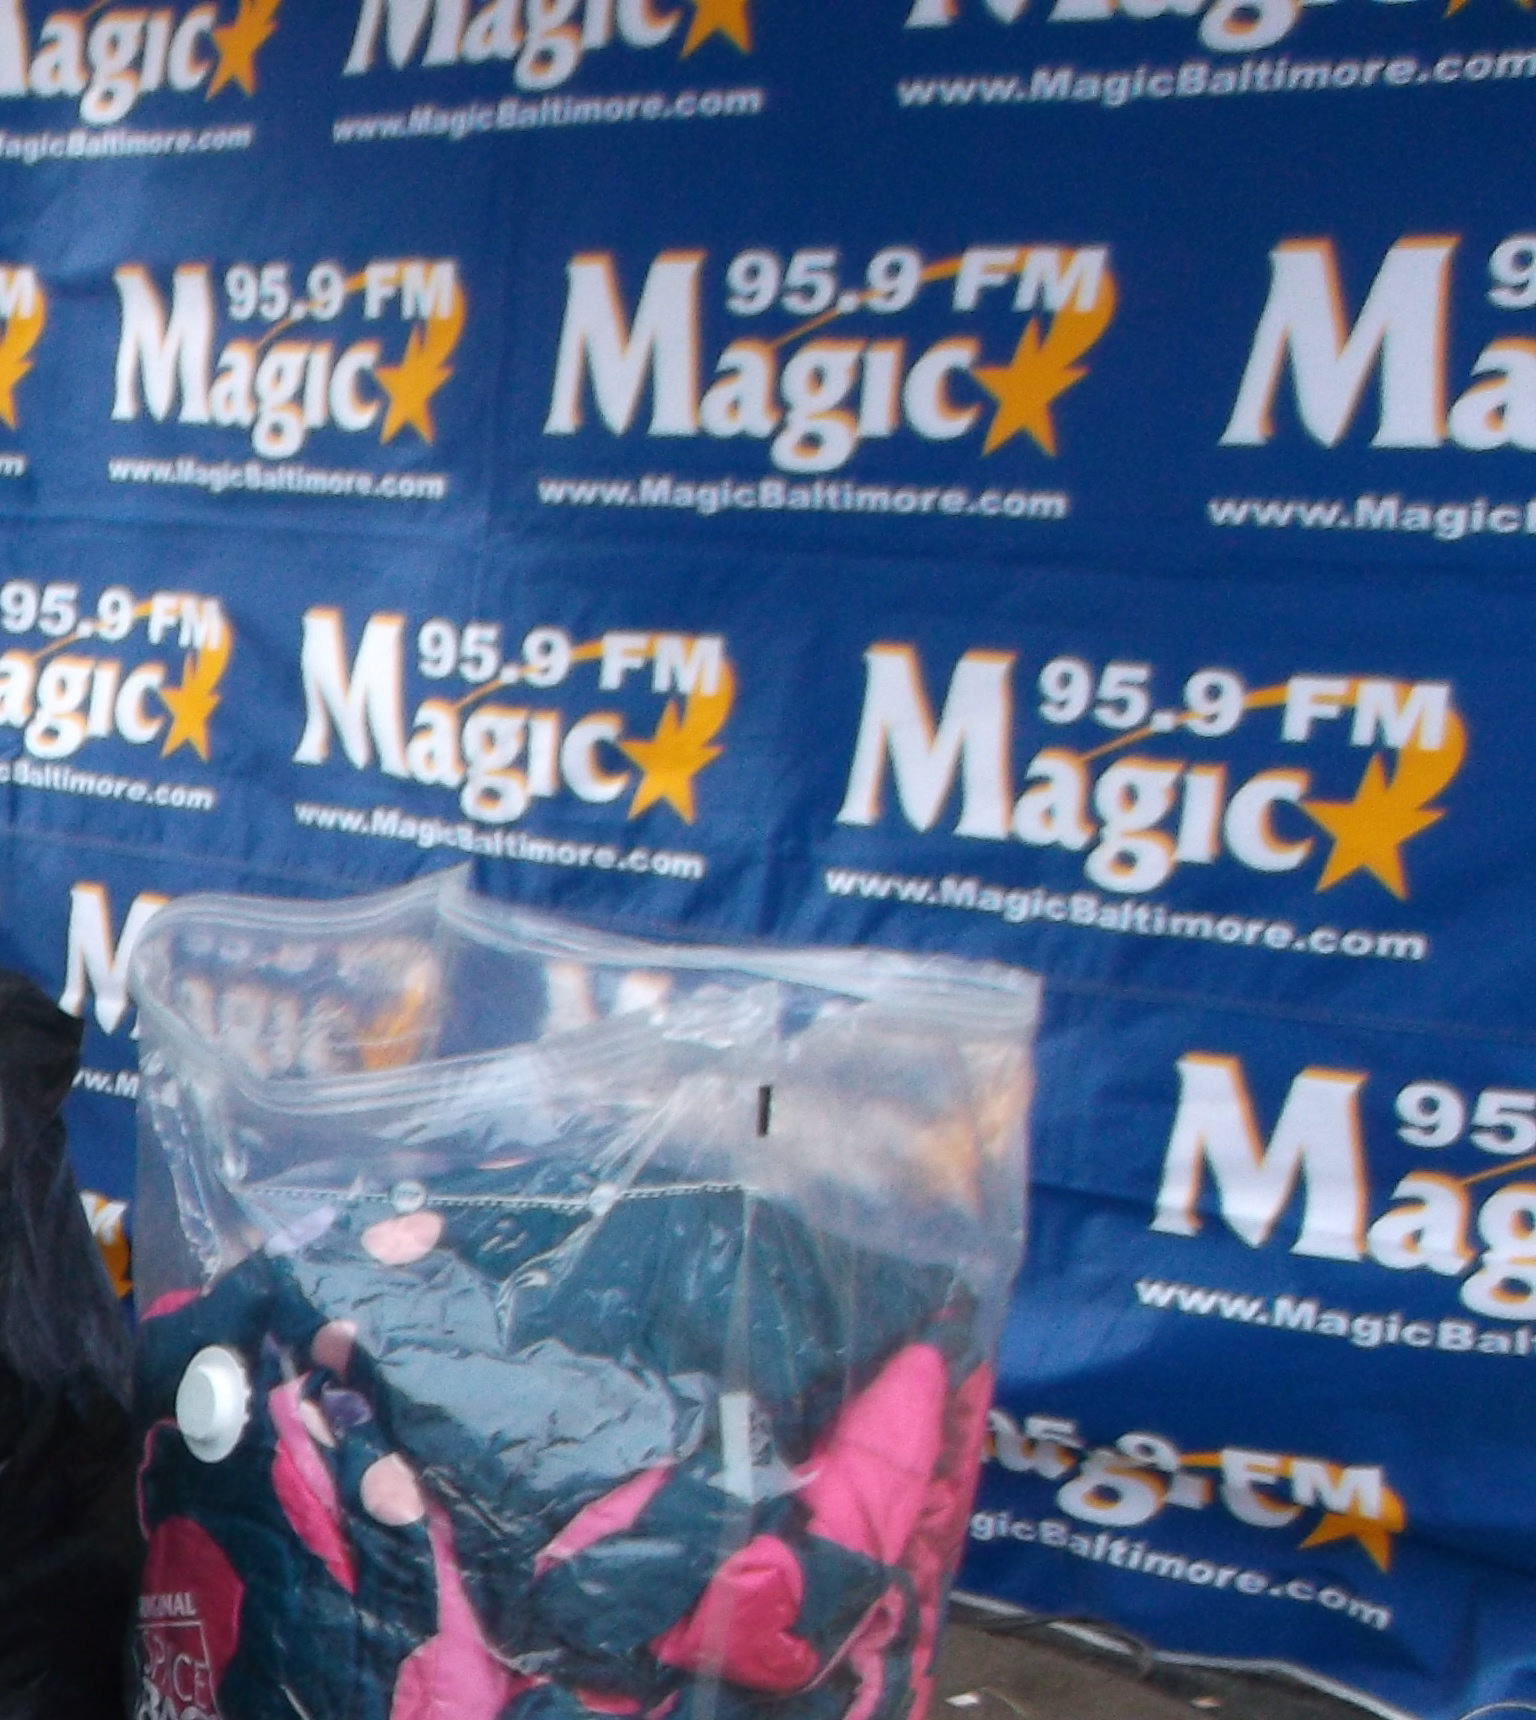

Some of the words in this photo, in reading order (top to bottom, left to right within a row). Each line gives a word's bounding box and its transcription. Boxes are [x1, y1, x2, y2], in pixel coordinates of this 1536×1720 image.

[332, 88, 765, 143] www.MagicBaltimore.com
[225, 261, 345, 321] 95.9
[362, 257, 458, 321] FM
[725, 246, 924, 318] 95.9
[951, 245, 1111, 314] FM
[112, 263, 381, 459] Magic
[543, 247, 983, 473] Magic
[108, 457, 446, 501] www.MagicBaltimore.com
[538, 476, 1069, 520] www.MagicBaltimore.com
[0, 580, 134, 639] 95.9
[146, 594, 222, 653] FM
[416, 617, 573, 689] 95.9
[598, 628, 726, 697] FM
[291, 604, 631, 825] Magic
[1038, 657, 1246, 737] 95.9
[1279, 674, 1452, 752] FM
[835, 642, 1315, 893] Magic
[292, 800, 708, 881] www.MagicBaltimore.com
[824, 864, 1428, 962] www.MagicBaltimore.com
